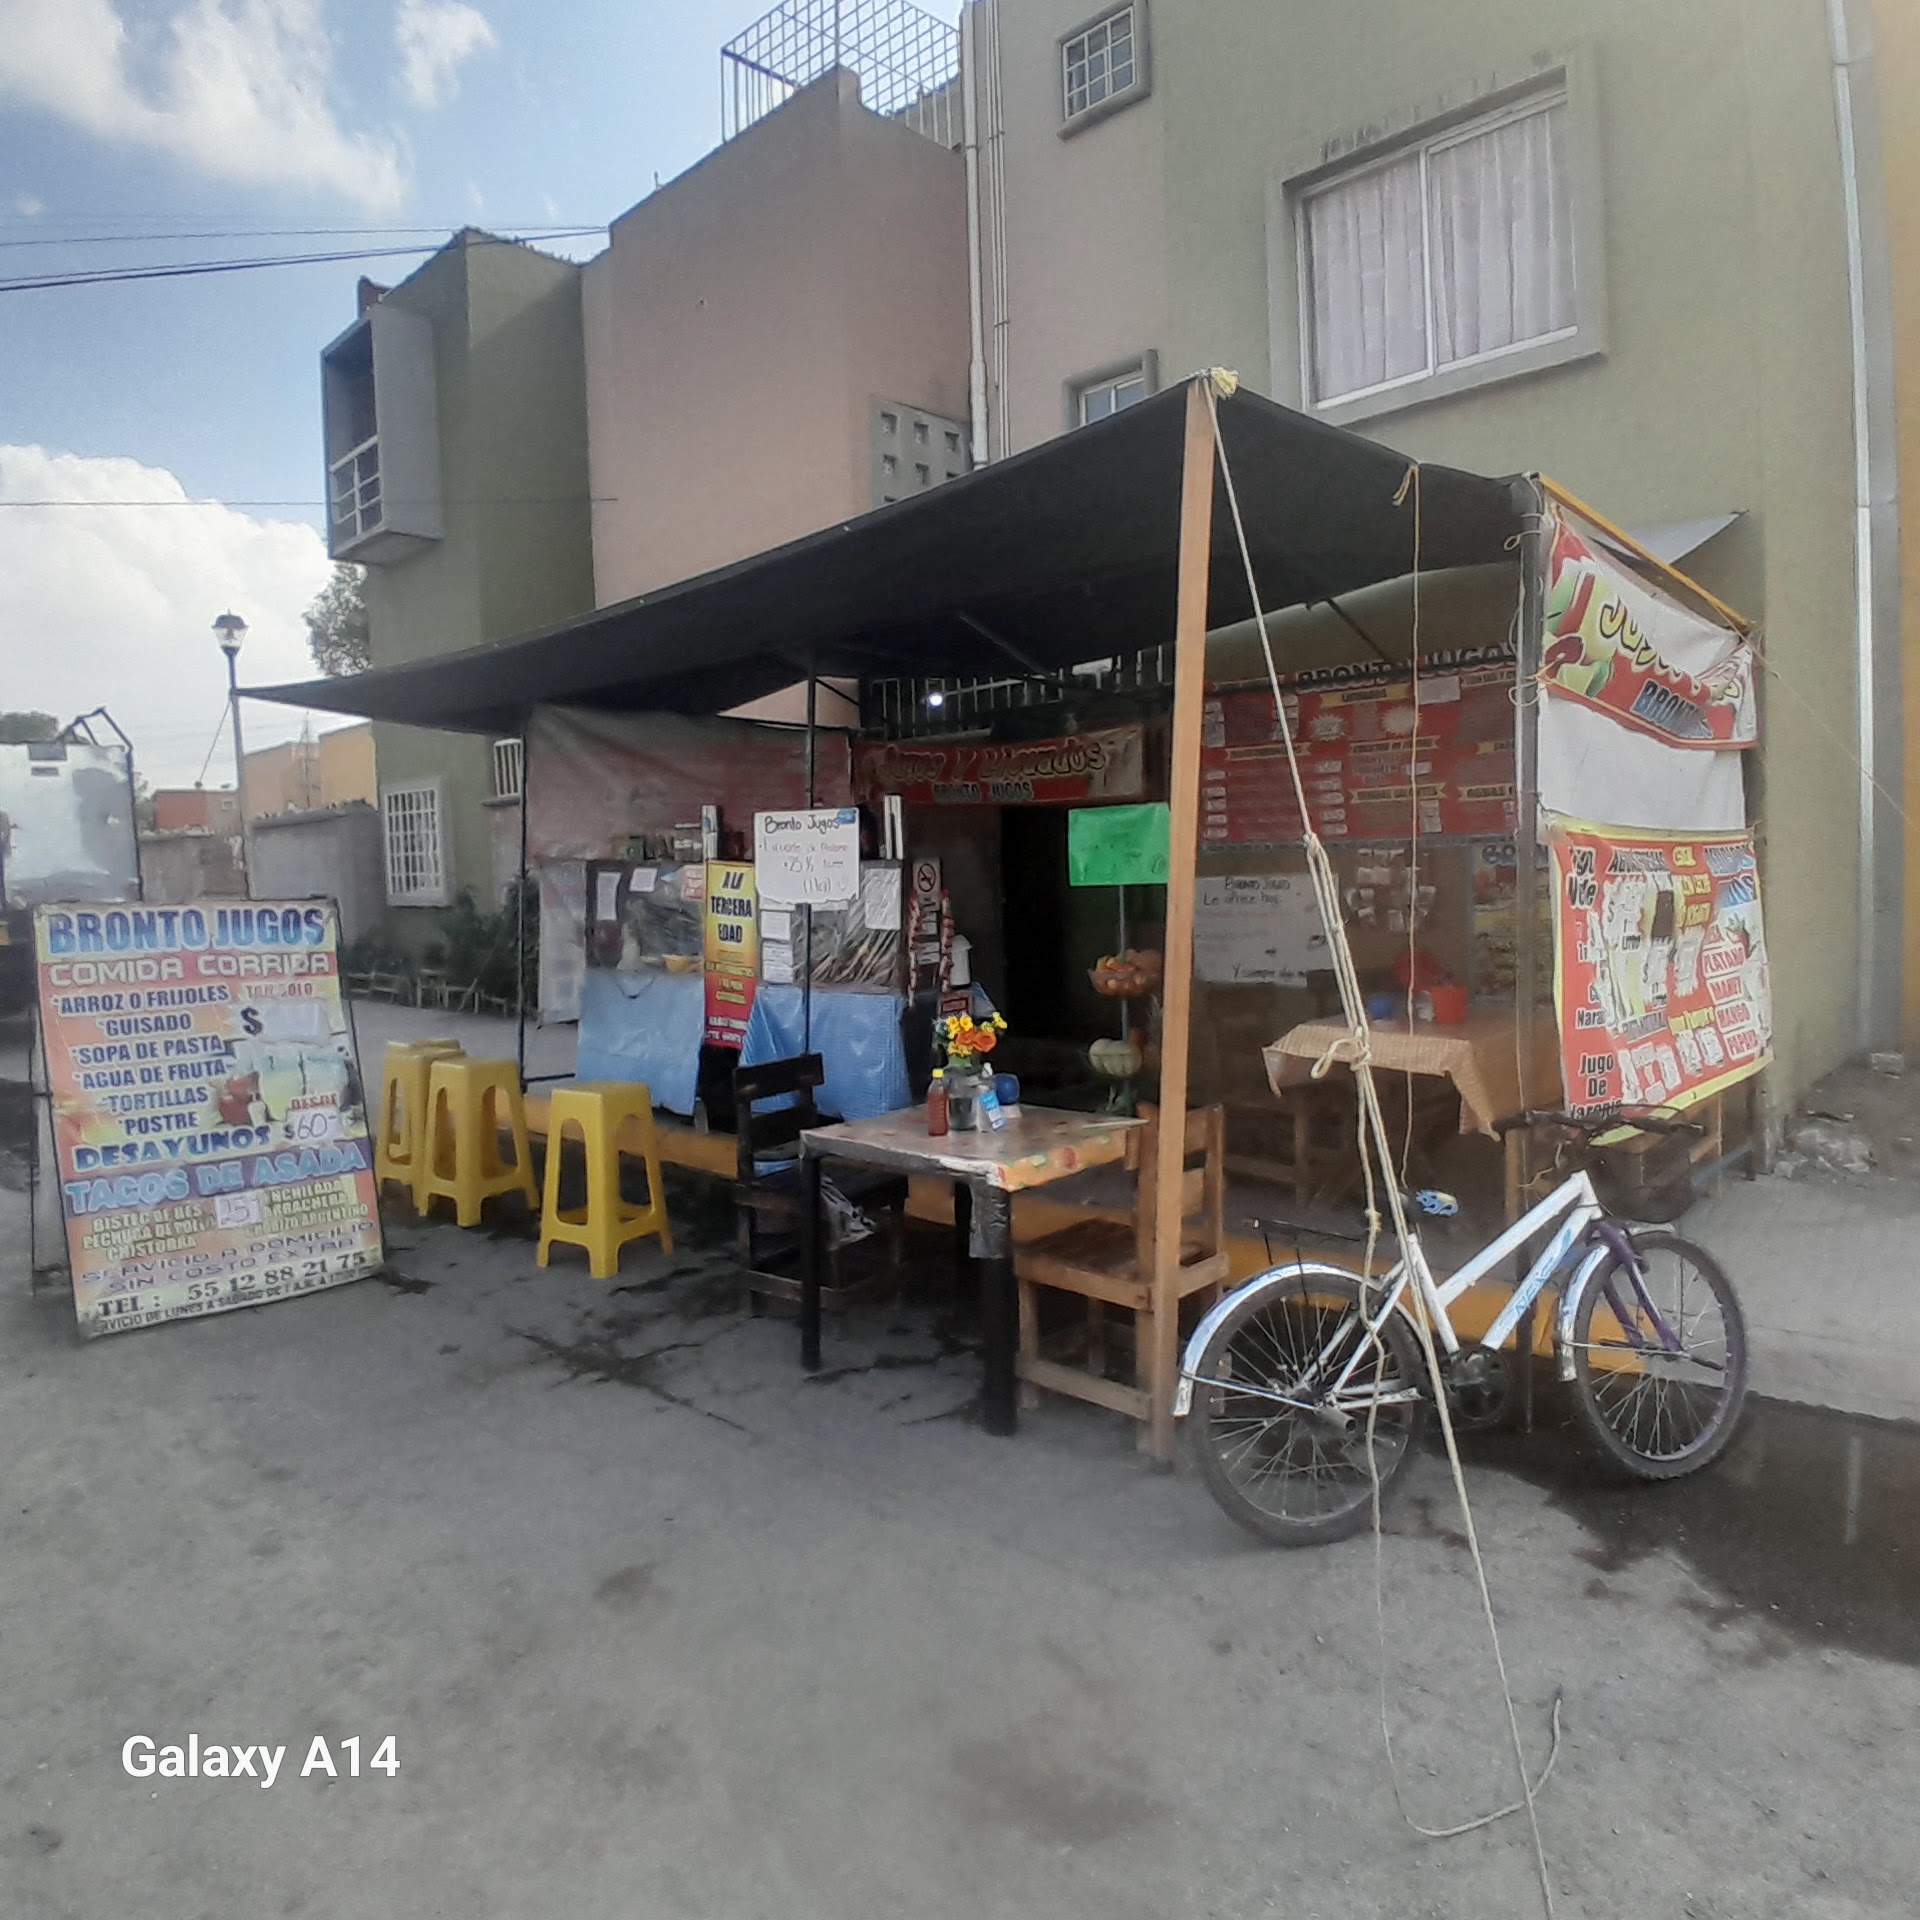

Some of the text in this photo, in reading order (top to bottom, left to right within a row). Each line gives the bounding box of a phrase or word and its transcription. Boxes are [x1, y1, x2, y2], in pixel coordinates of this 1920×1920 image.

[807, 814, 840, 835] Jugos
[48, 908, 325, 955] BRONTO JUGOS
[49, 952, 330, 988] COMIDA CORRIDA
[60, 991, 124, 1015] ARROZ
[130, 993, 142, 1010] O
[146, 985, 230, 1009] FRIJOLES
[105, 1013, 192, 1037] GUISADO
[78, 1034, 224, 1065] SOPA DE PASTA
[1580, 1053, 1614, 1076] Jugo
[82, 1057, 228, 1090] AGUA DE FRUTA
[1588, 1079, 1607, 1098] De
[107, 1086, 209, 1113] TORTILLAS
[123, 1113, 199, 1137] POSTRE
[75, 1124, 271, 1173] DESAYUNOS
[66, 1142, 368, 1215] TACOS DE ASADA
[187, 1280, 220, 1301] 55
[229, 1273, 256, 1292] 12
[264, 1265, 295, 1286] 88
[301, 1260, 328, 1278] 21
